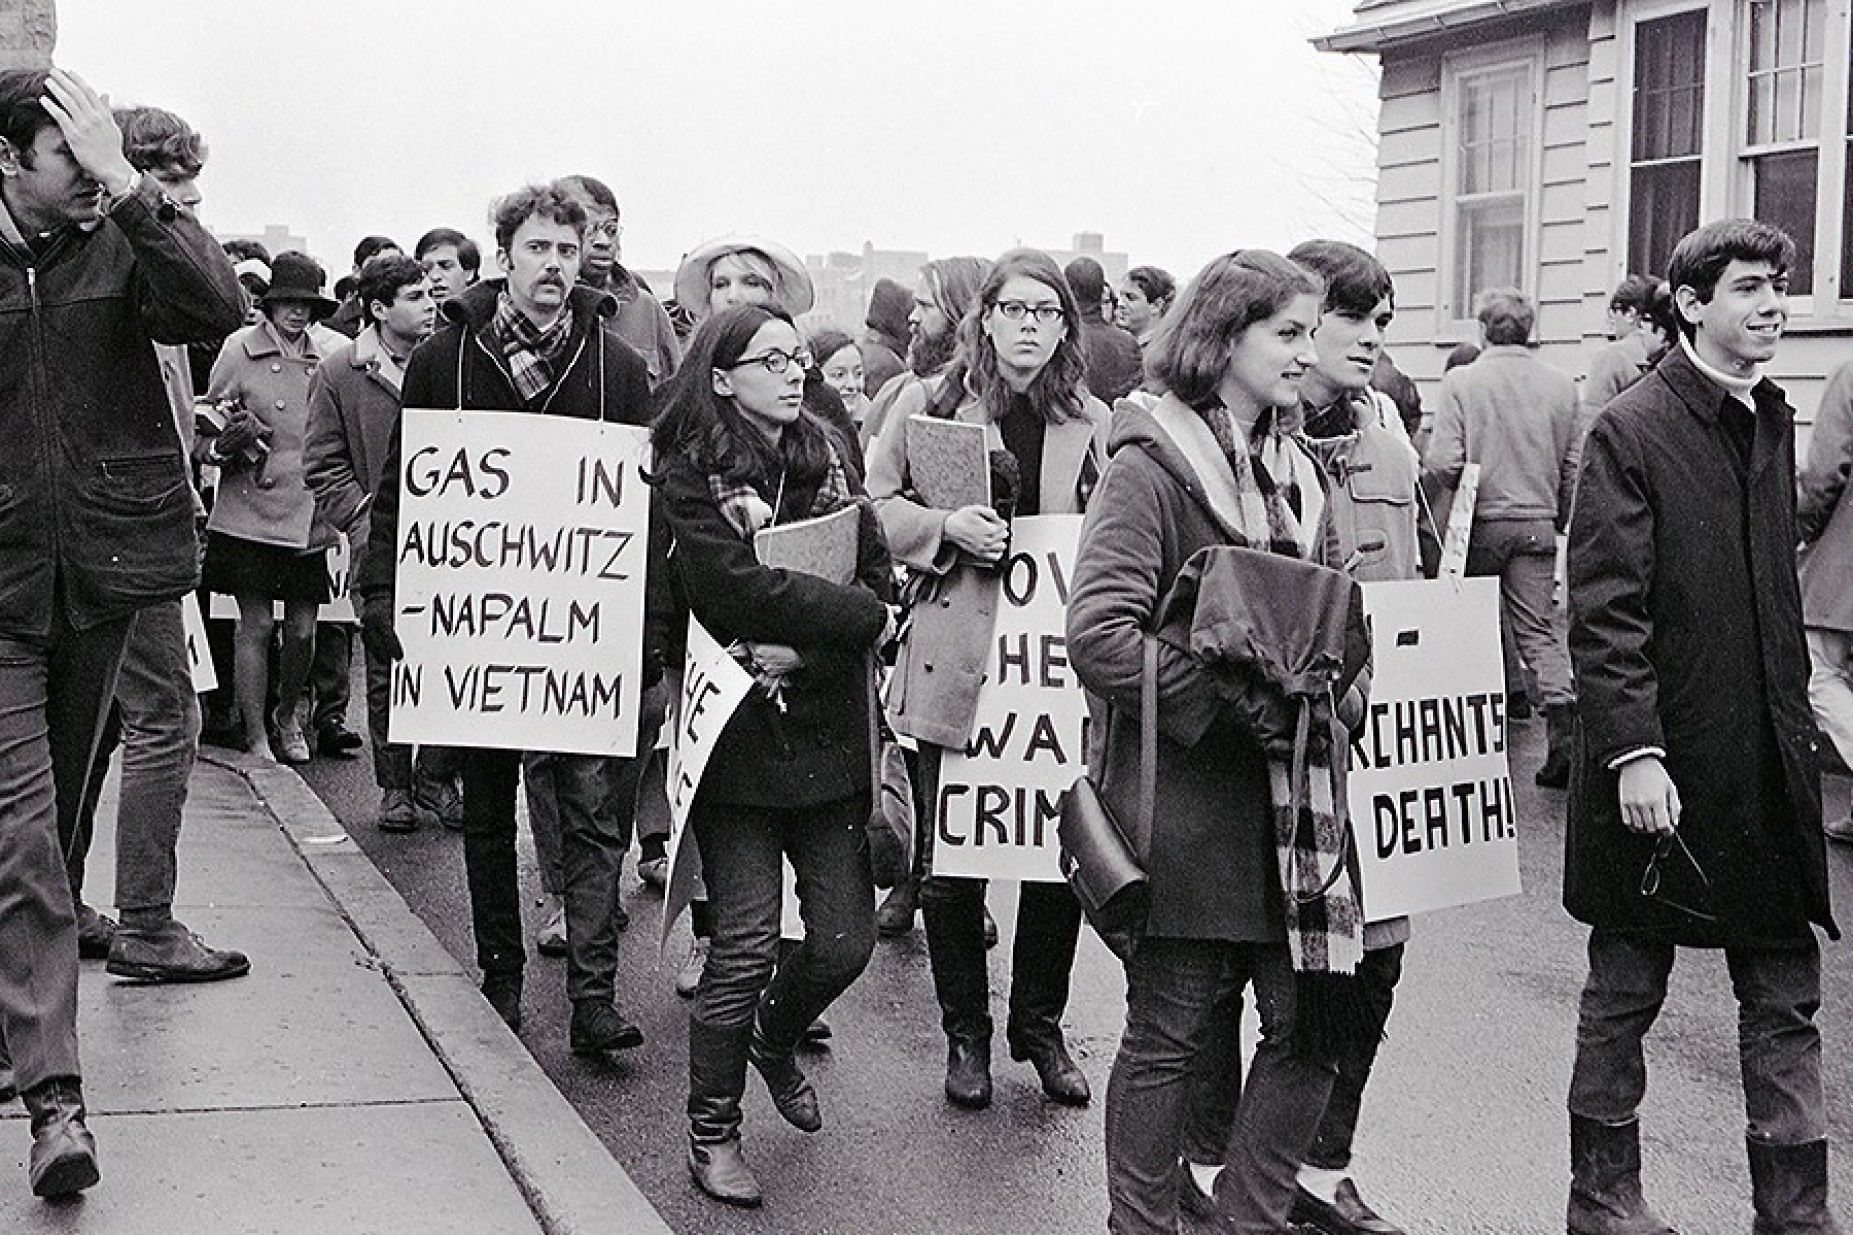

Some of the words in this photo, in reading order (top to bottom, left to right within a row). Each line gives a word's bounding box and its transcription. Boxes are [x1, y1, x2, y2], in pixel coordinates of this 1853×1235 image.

[405, 446, 511, 498] GAS
[576, 456, 624, 507] IN
[400, 520, 635, 579] AUSCHWITZ
[392, 663, 423, 708] IN
[444, 665, 623, 719] VIETNAM
[1373, 777, 1515, 860] DEATH!
